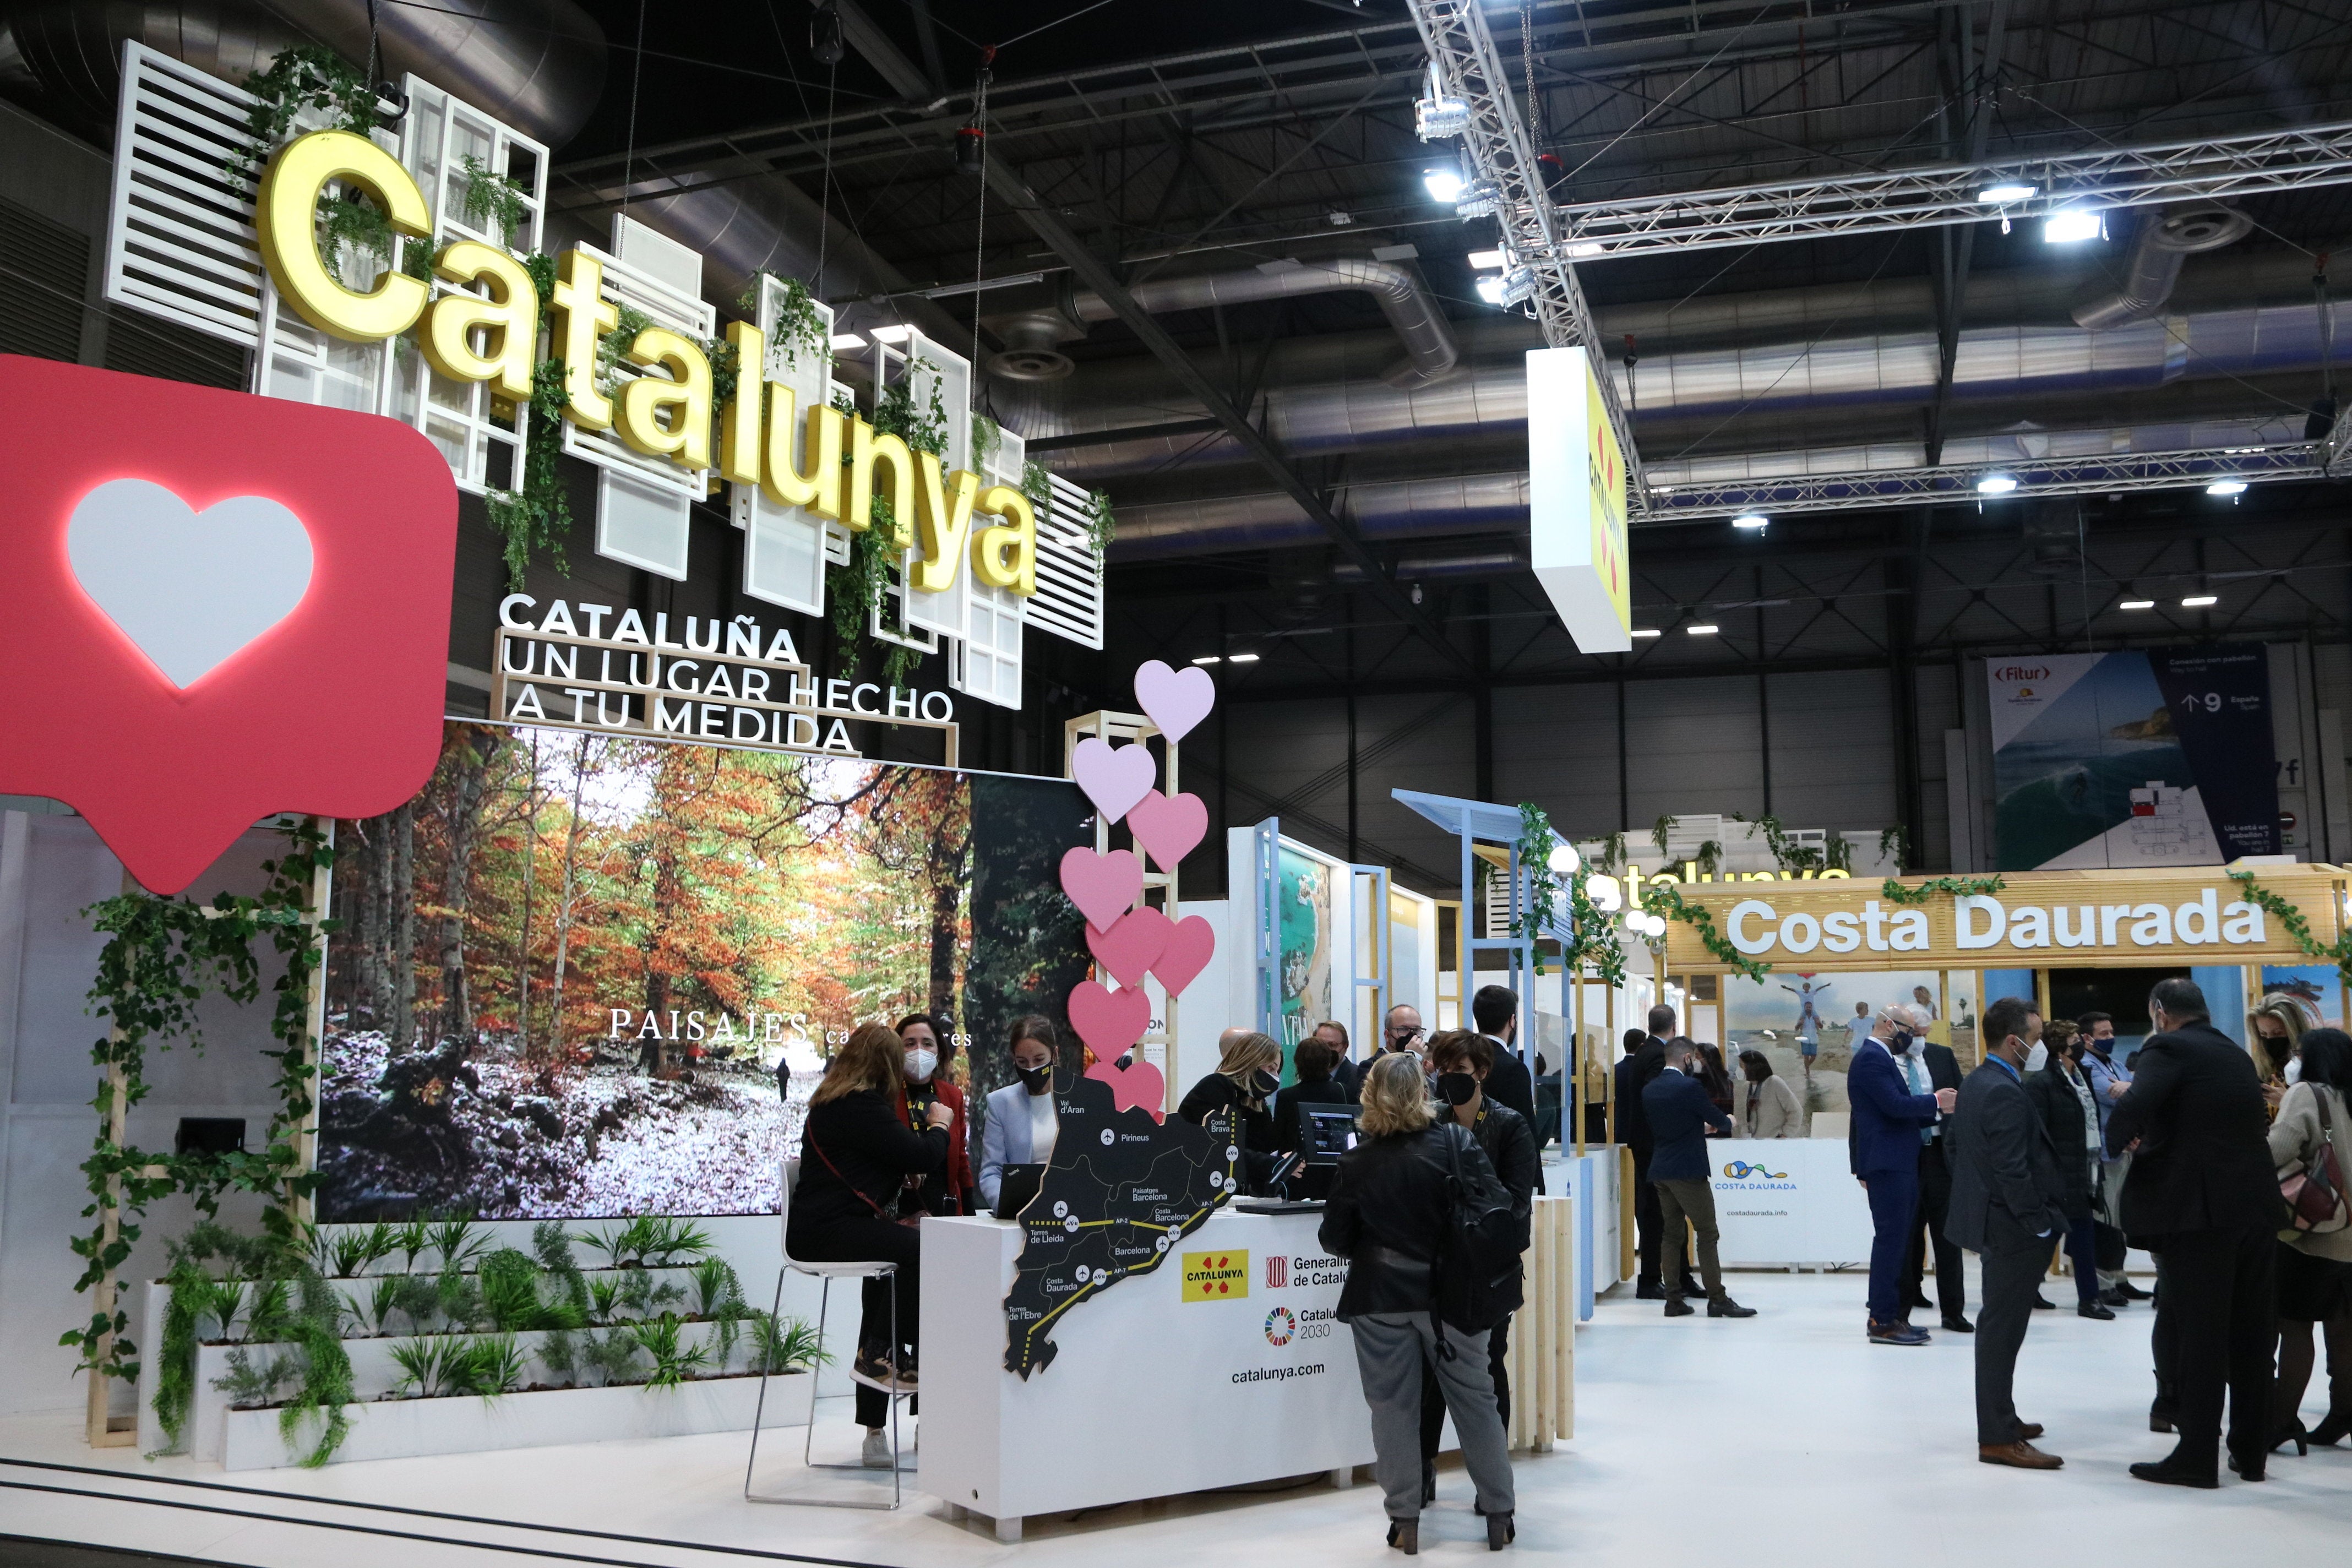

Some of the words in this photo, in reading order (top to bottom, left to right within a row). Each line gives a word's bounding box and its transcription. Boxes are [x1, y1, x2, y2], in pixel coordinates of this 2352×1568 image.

[257, 129, 1038, 598] Catalunya
[1588, 451, 1624, 561] CATALUNYA
[499, 592, 803, 665] CATALUÑA
[503, 637, 577, 679] UN
[602, 650, 770, 703] LUGAR
[790, 673, 954, 723] HECHO
[2006, 667, 2040, 680] Fitur
[2204, 692, 2222, 712] 9
[2230, 695, 2260, 704] España
[509, 683, 547, 720] A
[564, 688, 630, 728] TU
[653, 698, 854, 753] MEDIDA
[1727, 899, 1930, 954] Costa
[1954, 887, 2266, 949] Daurada
[609, 1008, 808, 1044] PAISAJES
[1121, 1134, 1149, 1142] Pirineus
[1133, 1193, 1167, 1201] Barcelona
[1155, 1213, 1189, 1222] Barcelona
[1042, 1235, 1064, 1243] Lleida
[1115, 1246, 1150, 1255] Barcelona
[1294, 1256, 1351, 1270] Generalit
[1187, 1269, 1243, 1282] CATALUNYA
[1294, 1274, 1308, 1287] de
[1312, 1271, 1346, 1285] Catal
[1047, 1283, 1077, 1292] Daurada
[1020, 1311, 1042, 1320] l'Ebre
[1300, 1308, 1335, 1321] Catalu
[1300, 1324, 1330, 1339] 2030
[1232, 1363, 1325, 1384] catalunya.com
